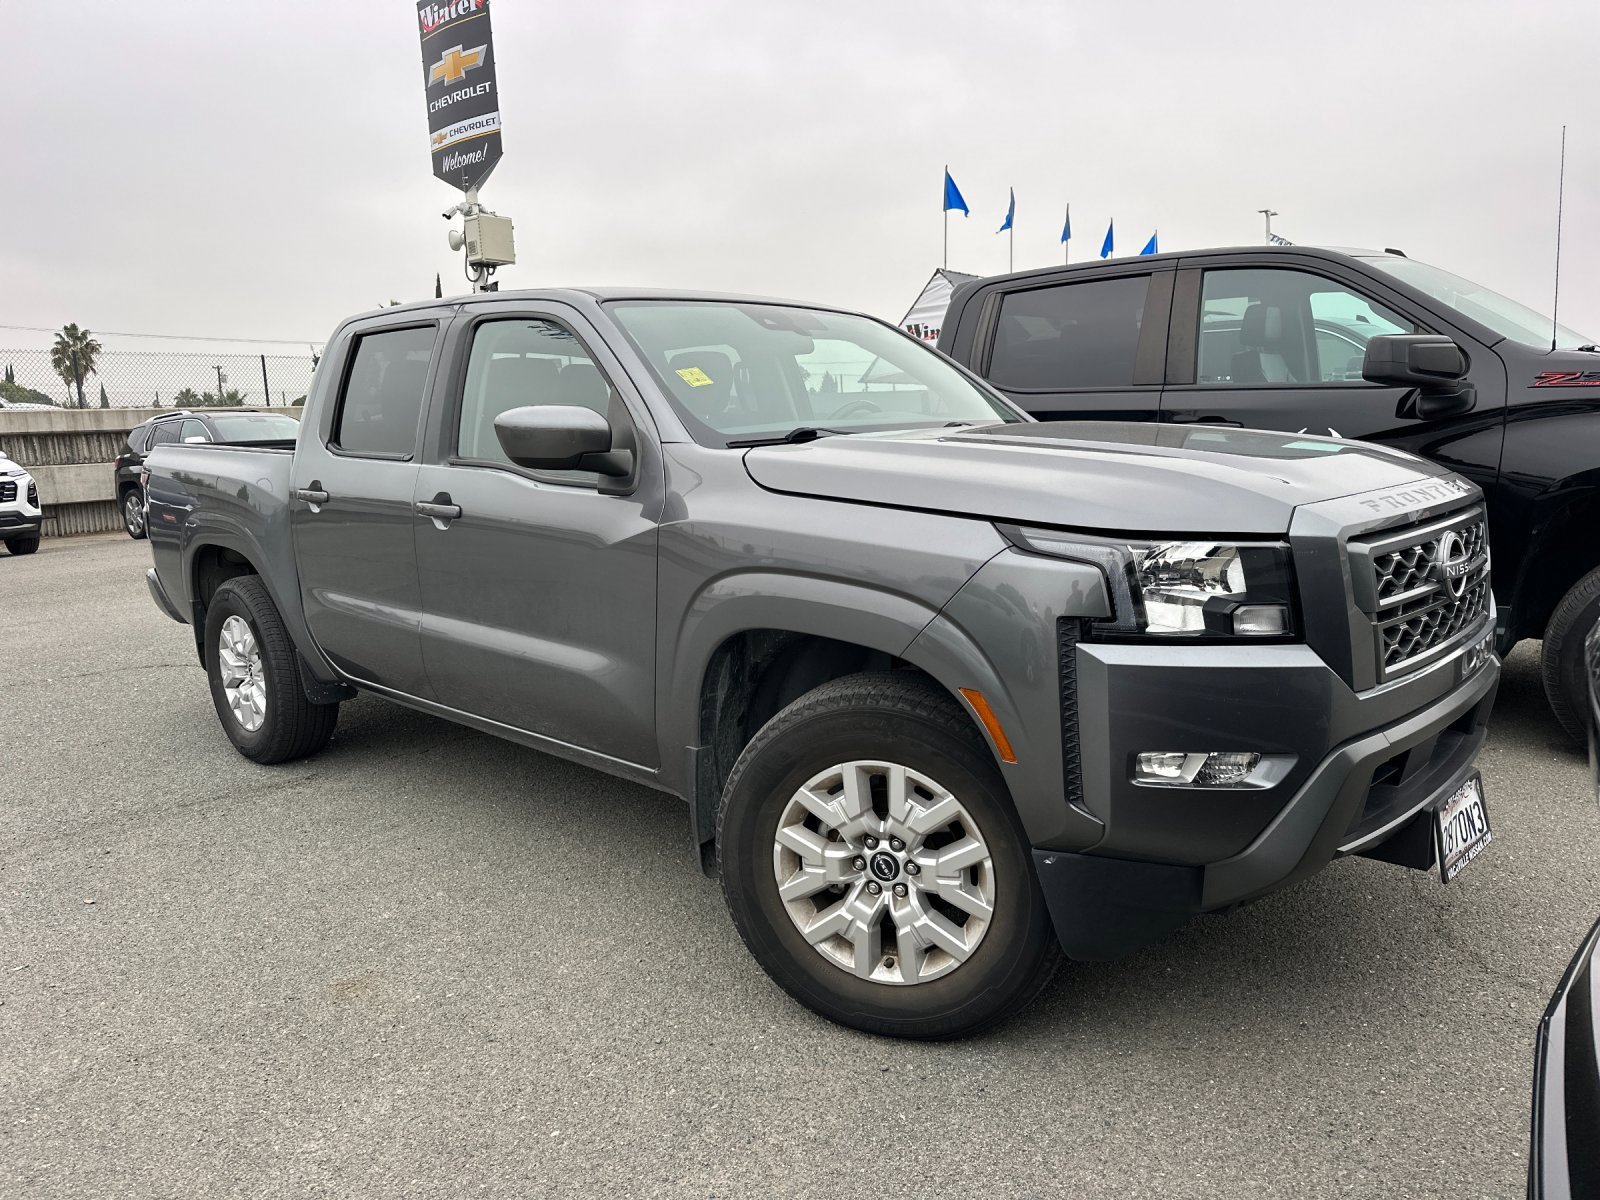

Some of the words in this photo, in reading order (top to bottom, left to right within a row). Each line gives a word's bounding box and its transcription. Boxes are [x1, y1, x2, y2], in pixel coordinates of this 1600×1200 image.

[430, 81, 491, 113] CHEVROLET
[449, 117, 496, 137] CHEVROLET
[442, 142, 488, 173] Welcome!
[905, 322, 941, 341] Win
[1446, 562, 1470, 577] NISS
